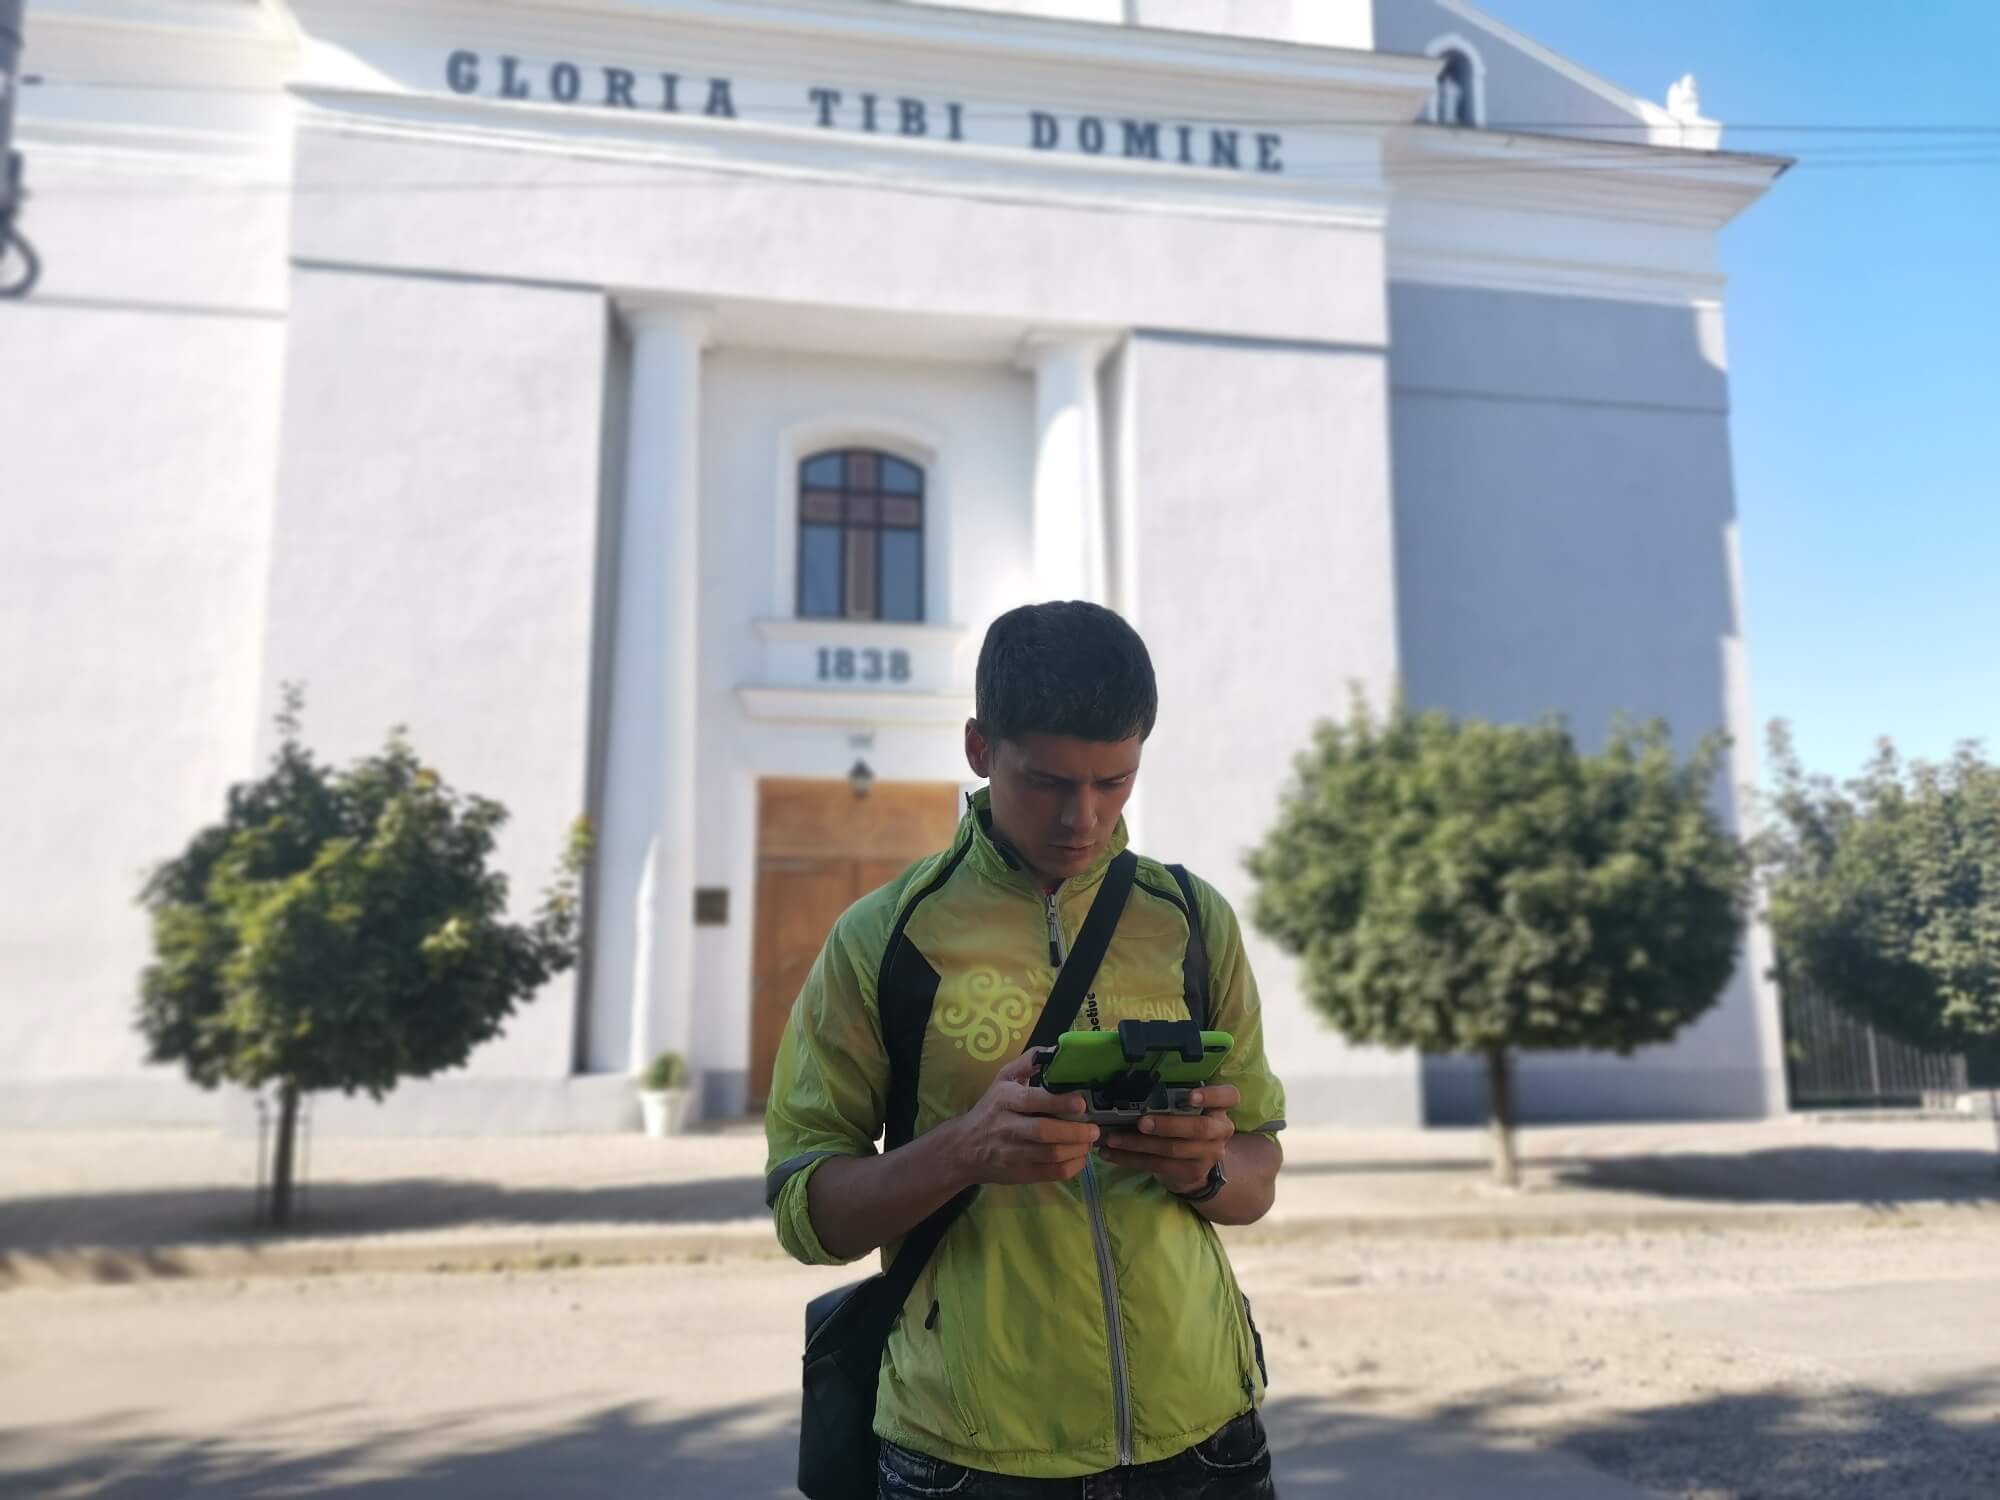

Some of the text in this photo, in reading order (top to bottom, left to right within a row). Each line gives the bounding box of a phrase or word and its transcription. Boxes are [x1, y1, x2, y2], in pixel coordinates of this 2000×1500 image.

[446, 50, 1283, 173] GLORIA TIBI DOMINE
[816, 647, 912, 682] 1838
